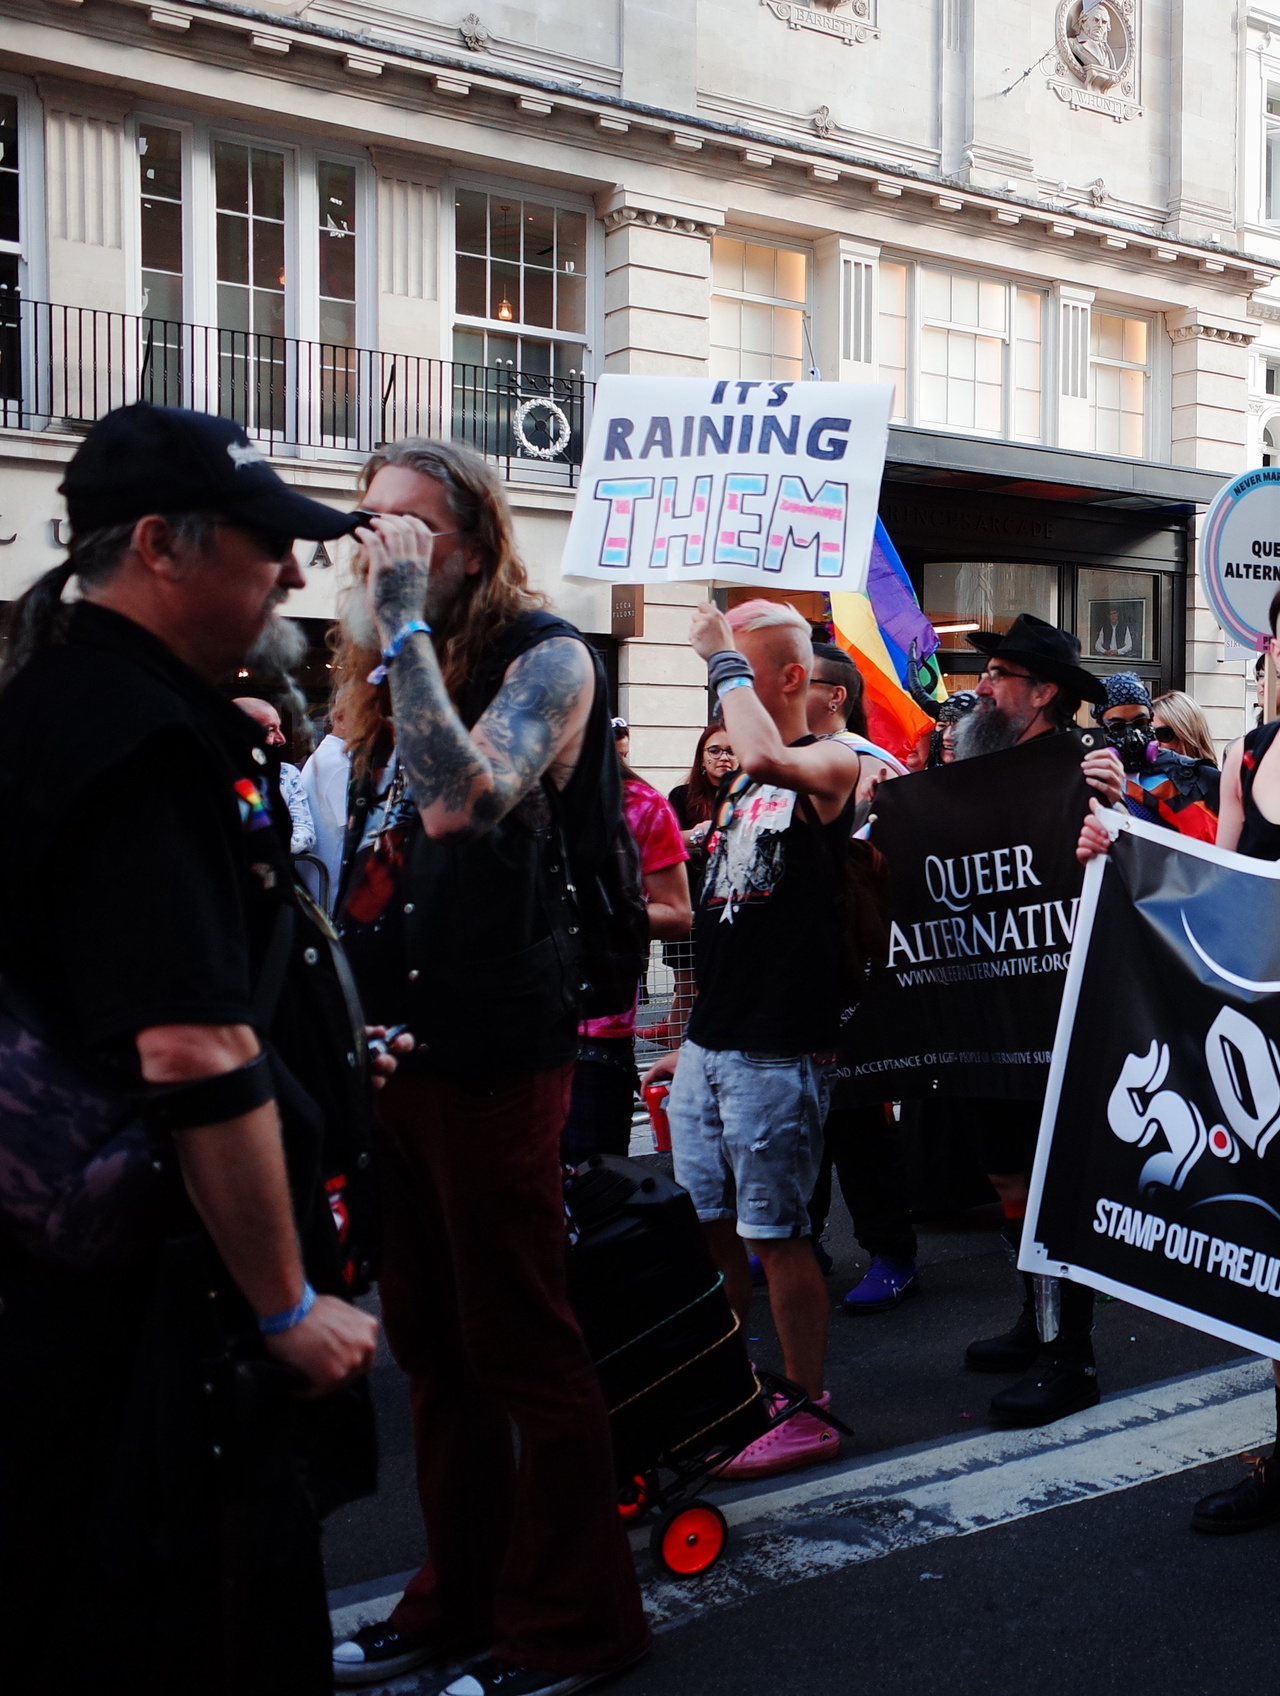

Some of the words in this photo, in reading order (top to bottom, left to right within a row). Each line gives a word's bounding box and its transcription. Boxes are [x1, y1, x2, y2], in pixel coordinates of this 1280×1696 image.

[711, 380, 794, 407] IT'S
[603, 414, 852, 461] RAINING
[1233, 474, 1262, 496] NEVER
[594, 472, 849, 578] THEM
[925, 844, 1042, 912] QUEER
[855, 1055, 922, 1076] ACCEPTANCE
[924, 1053, 937, 1065] OF
[1092, 1197, 1166, 1252] STAMP
[1164, 1222, 1210, 1269] OUT
